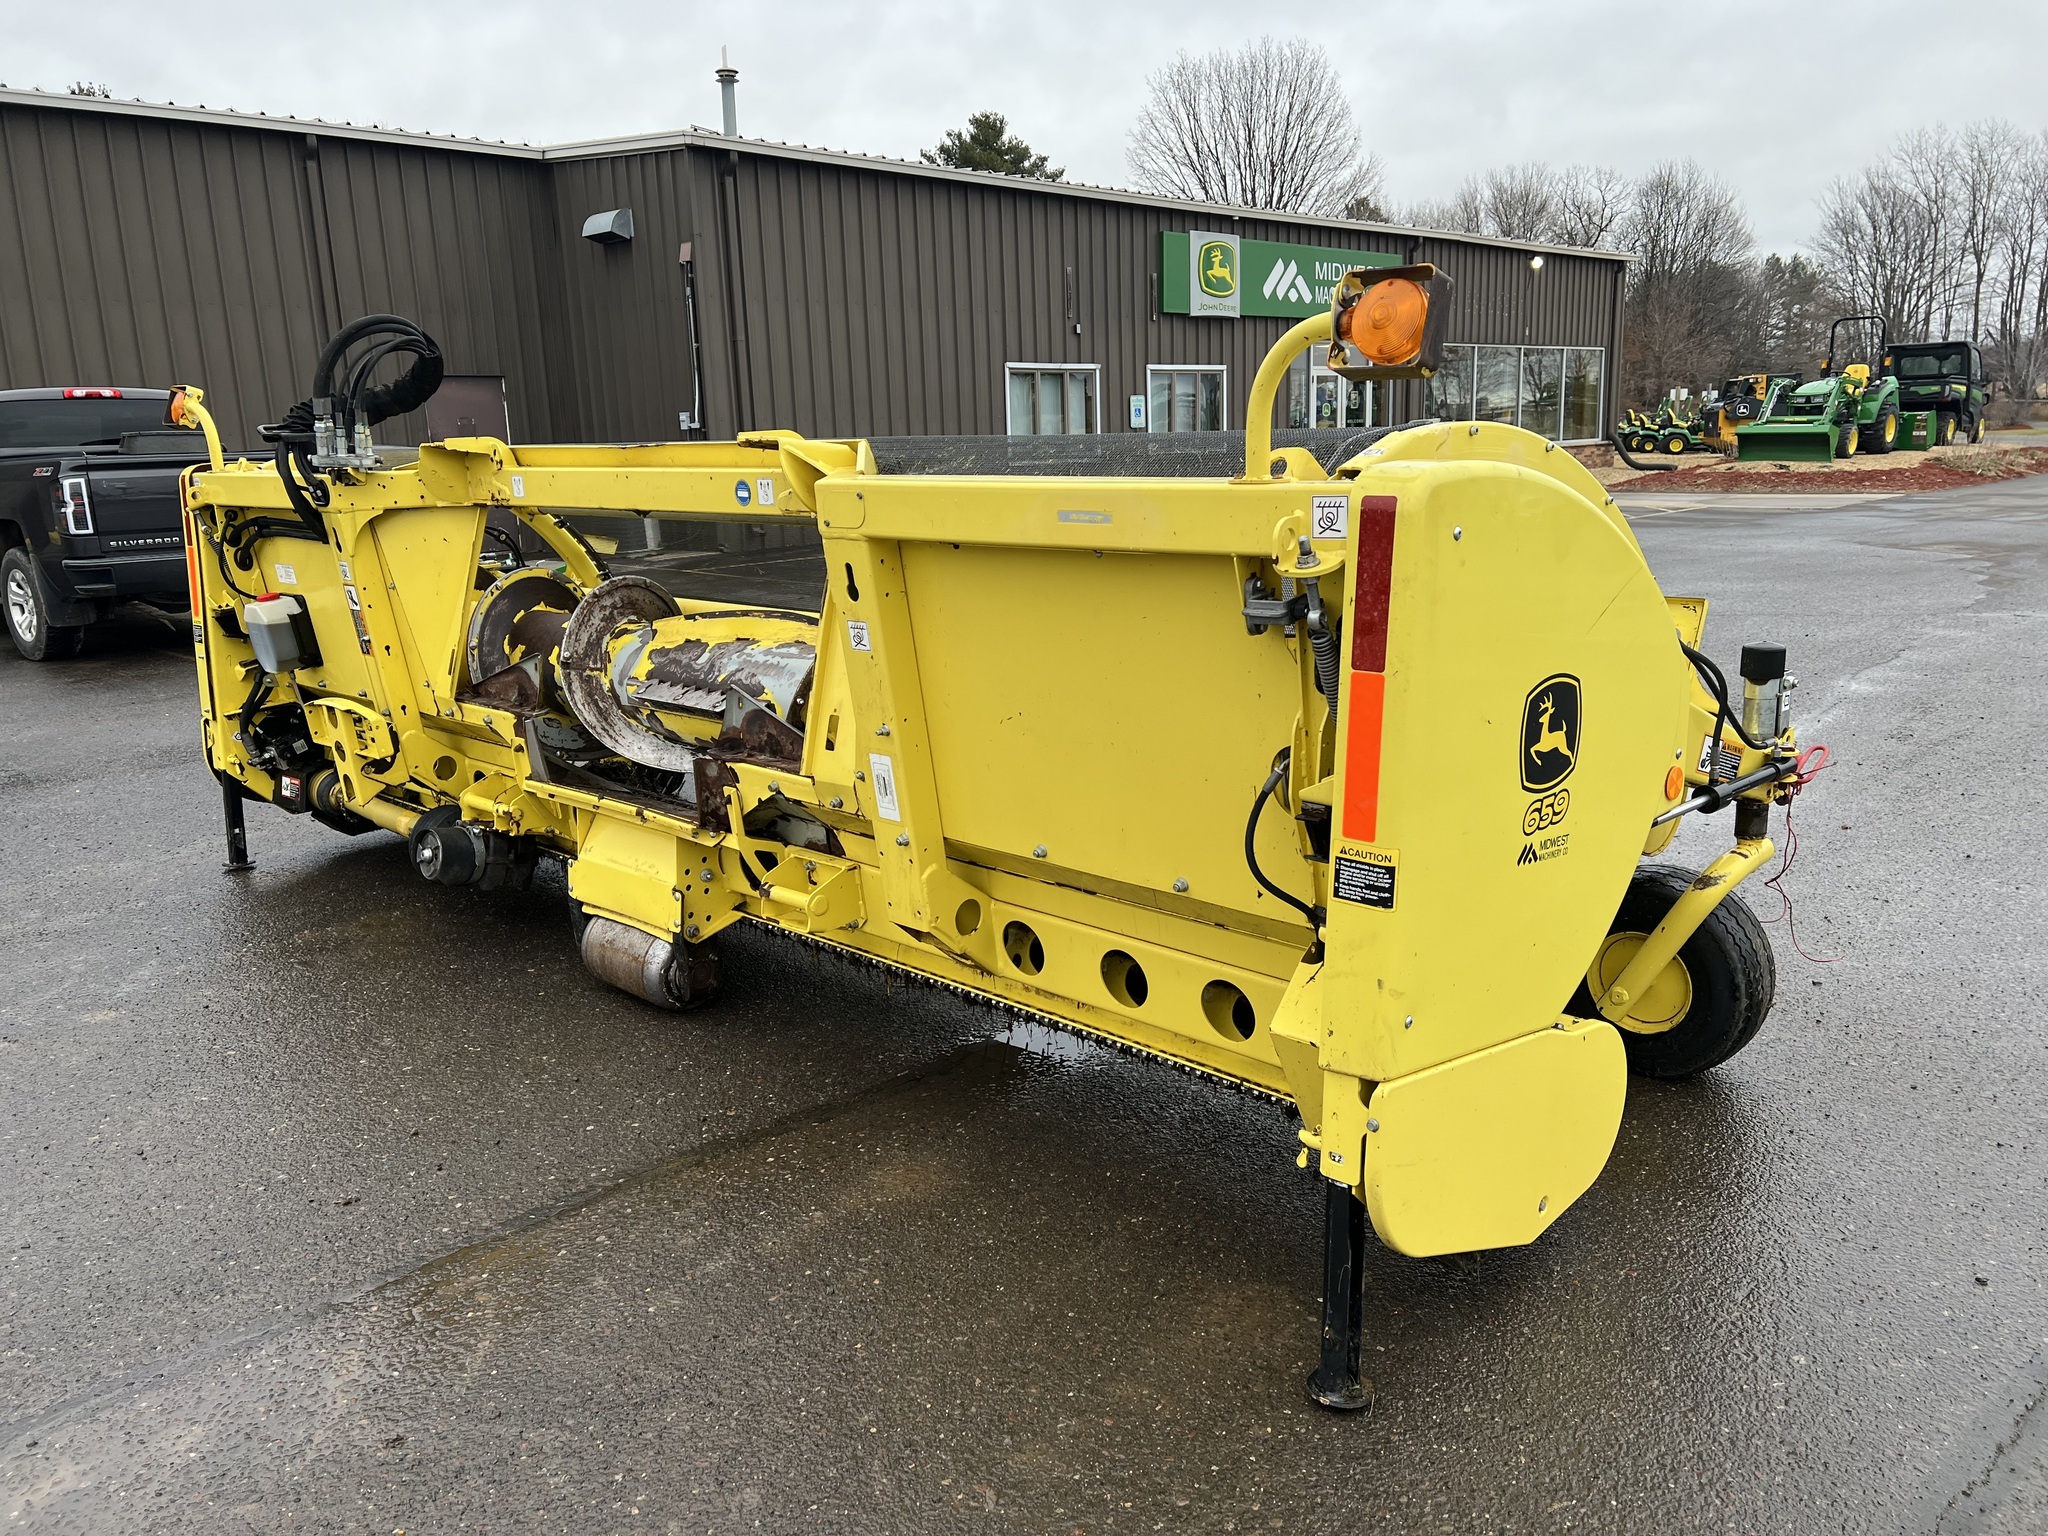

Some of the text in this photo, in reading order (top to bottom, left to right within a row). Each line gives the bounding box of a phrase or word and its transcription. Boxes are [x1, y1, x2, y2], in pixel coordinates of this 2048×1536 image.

[1198, 303, 1237, 313] JOHN DEERE
[109, 537, 180, 548] SILVERADO
[1522, 788, 1570, 836] 659
[1539, 834, 1570, 851] MIDWEST
[1348, 848, 1392, 863] CAUTION
[1539, 849, 1562, 862] MACHINERY
